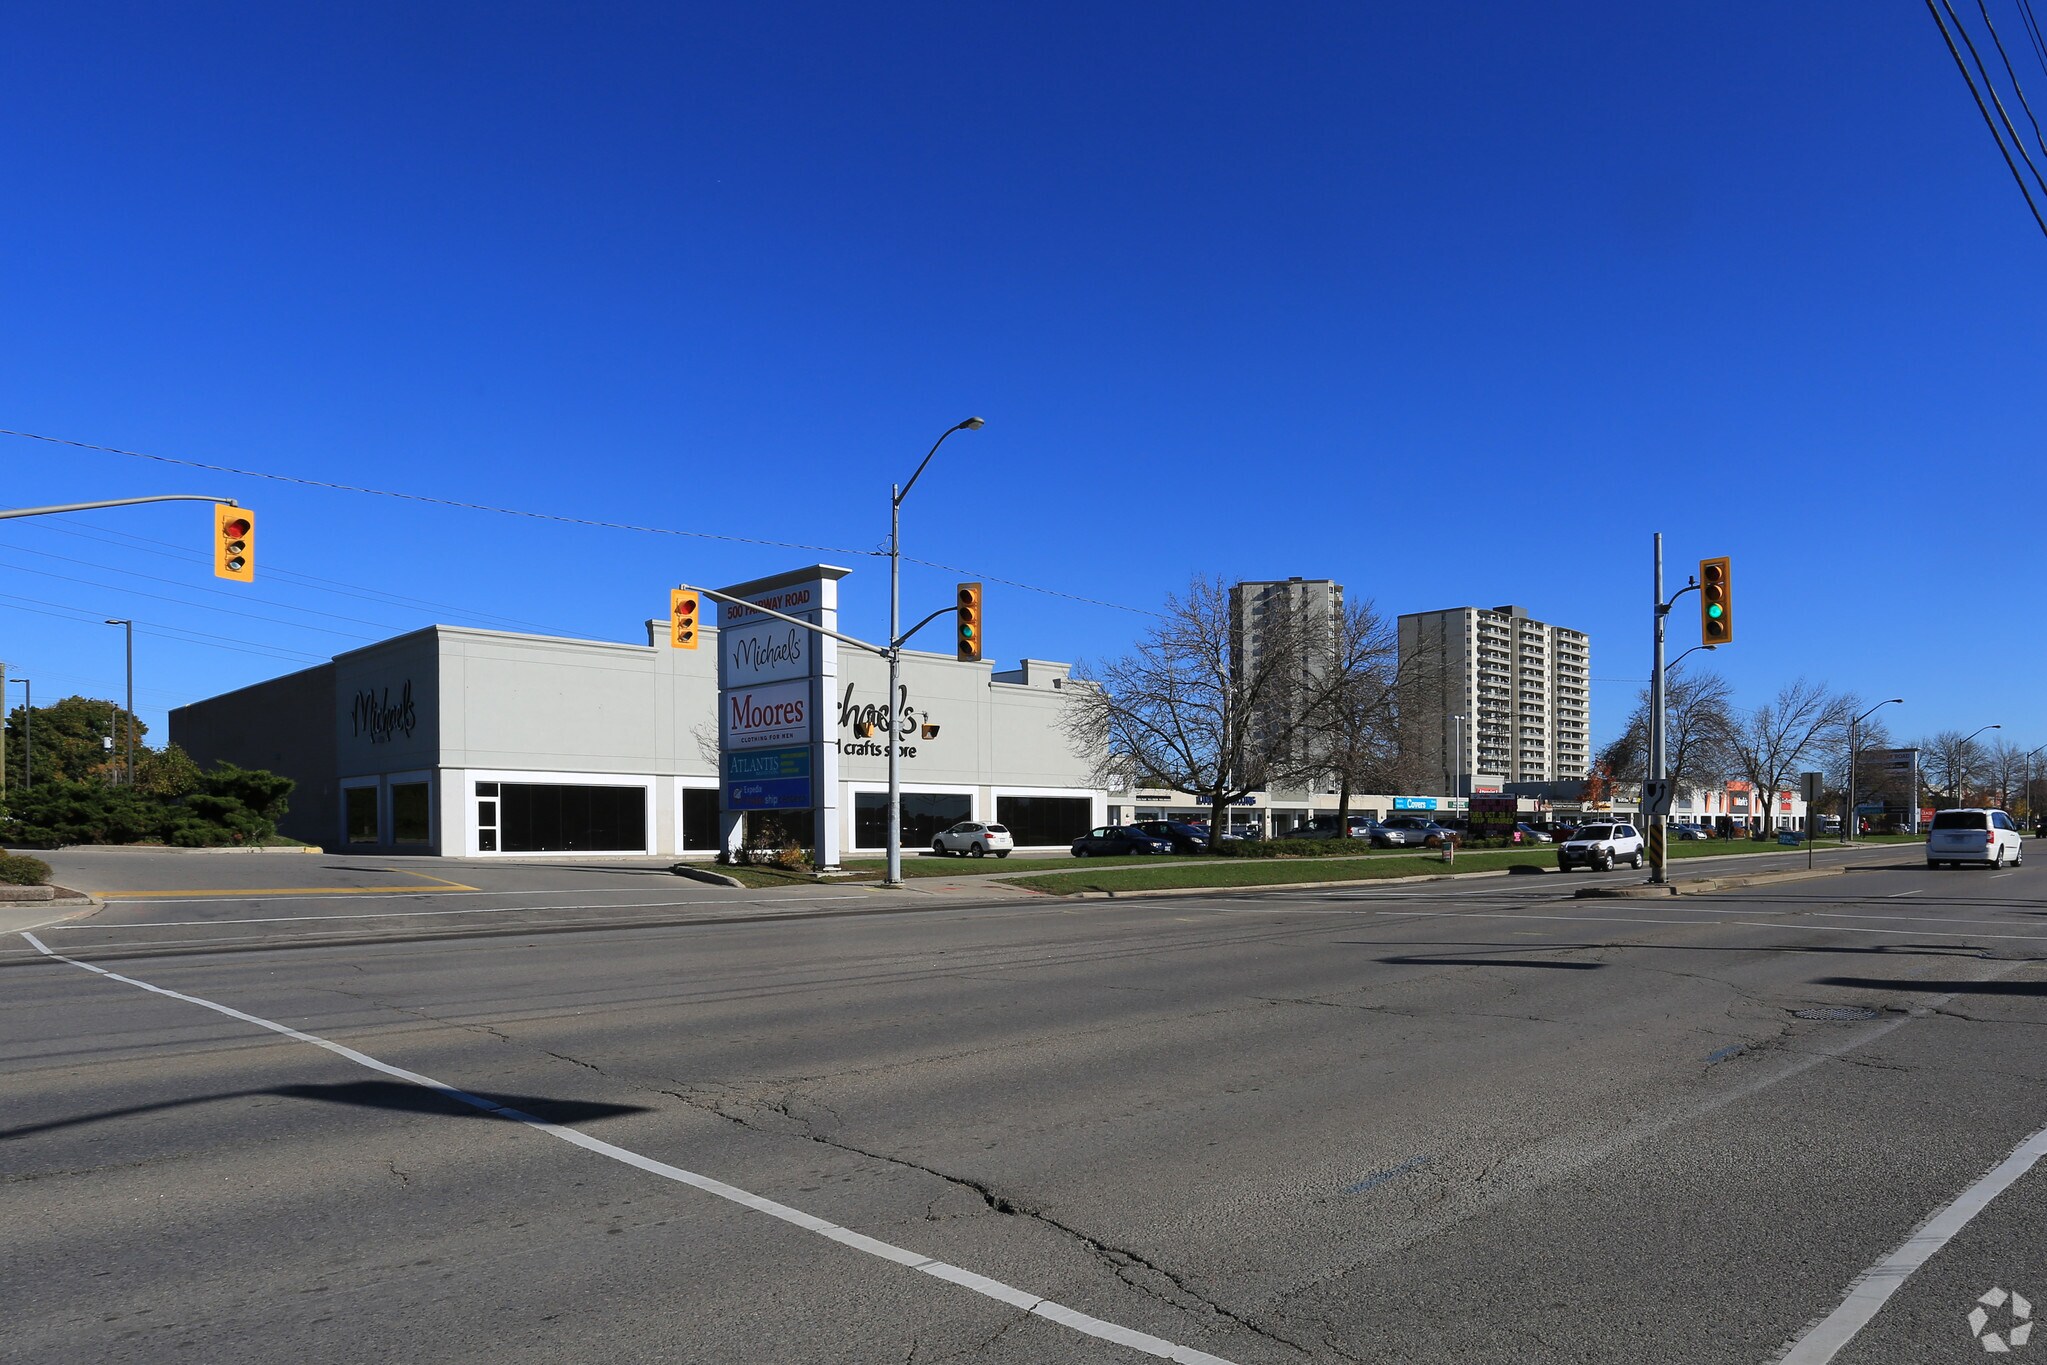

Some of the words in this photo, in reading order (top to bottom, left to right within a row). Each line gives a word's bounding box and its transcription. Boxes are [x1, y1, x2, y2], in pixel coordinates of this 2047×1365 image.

[727, 605, 743, 619] 500
[785, 590, 810, 607] ROAD
[733, 628, 800, 671] Michaels
[351, 679, 416, 744] Michaels
[731, 694, 804, 730] Moores
[741, 735, 767, 743] CLOTHING
[843, 740, 882, 757] crafts
[884, 745, 917, 758] sore
[730, 756, 779, 774] ATLANTIS
[1407, 799, 1426, 809] Covers
